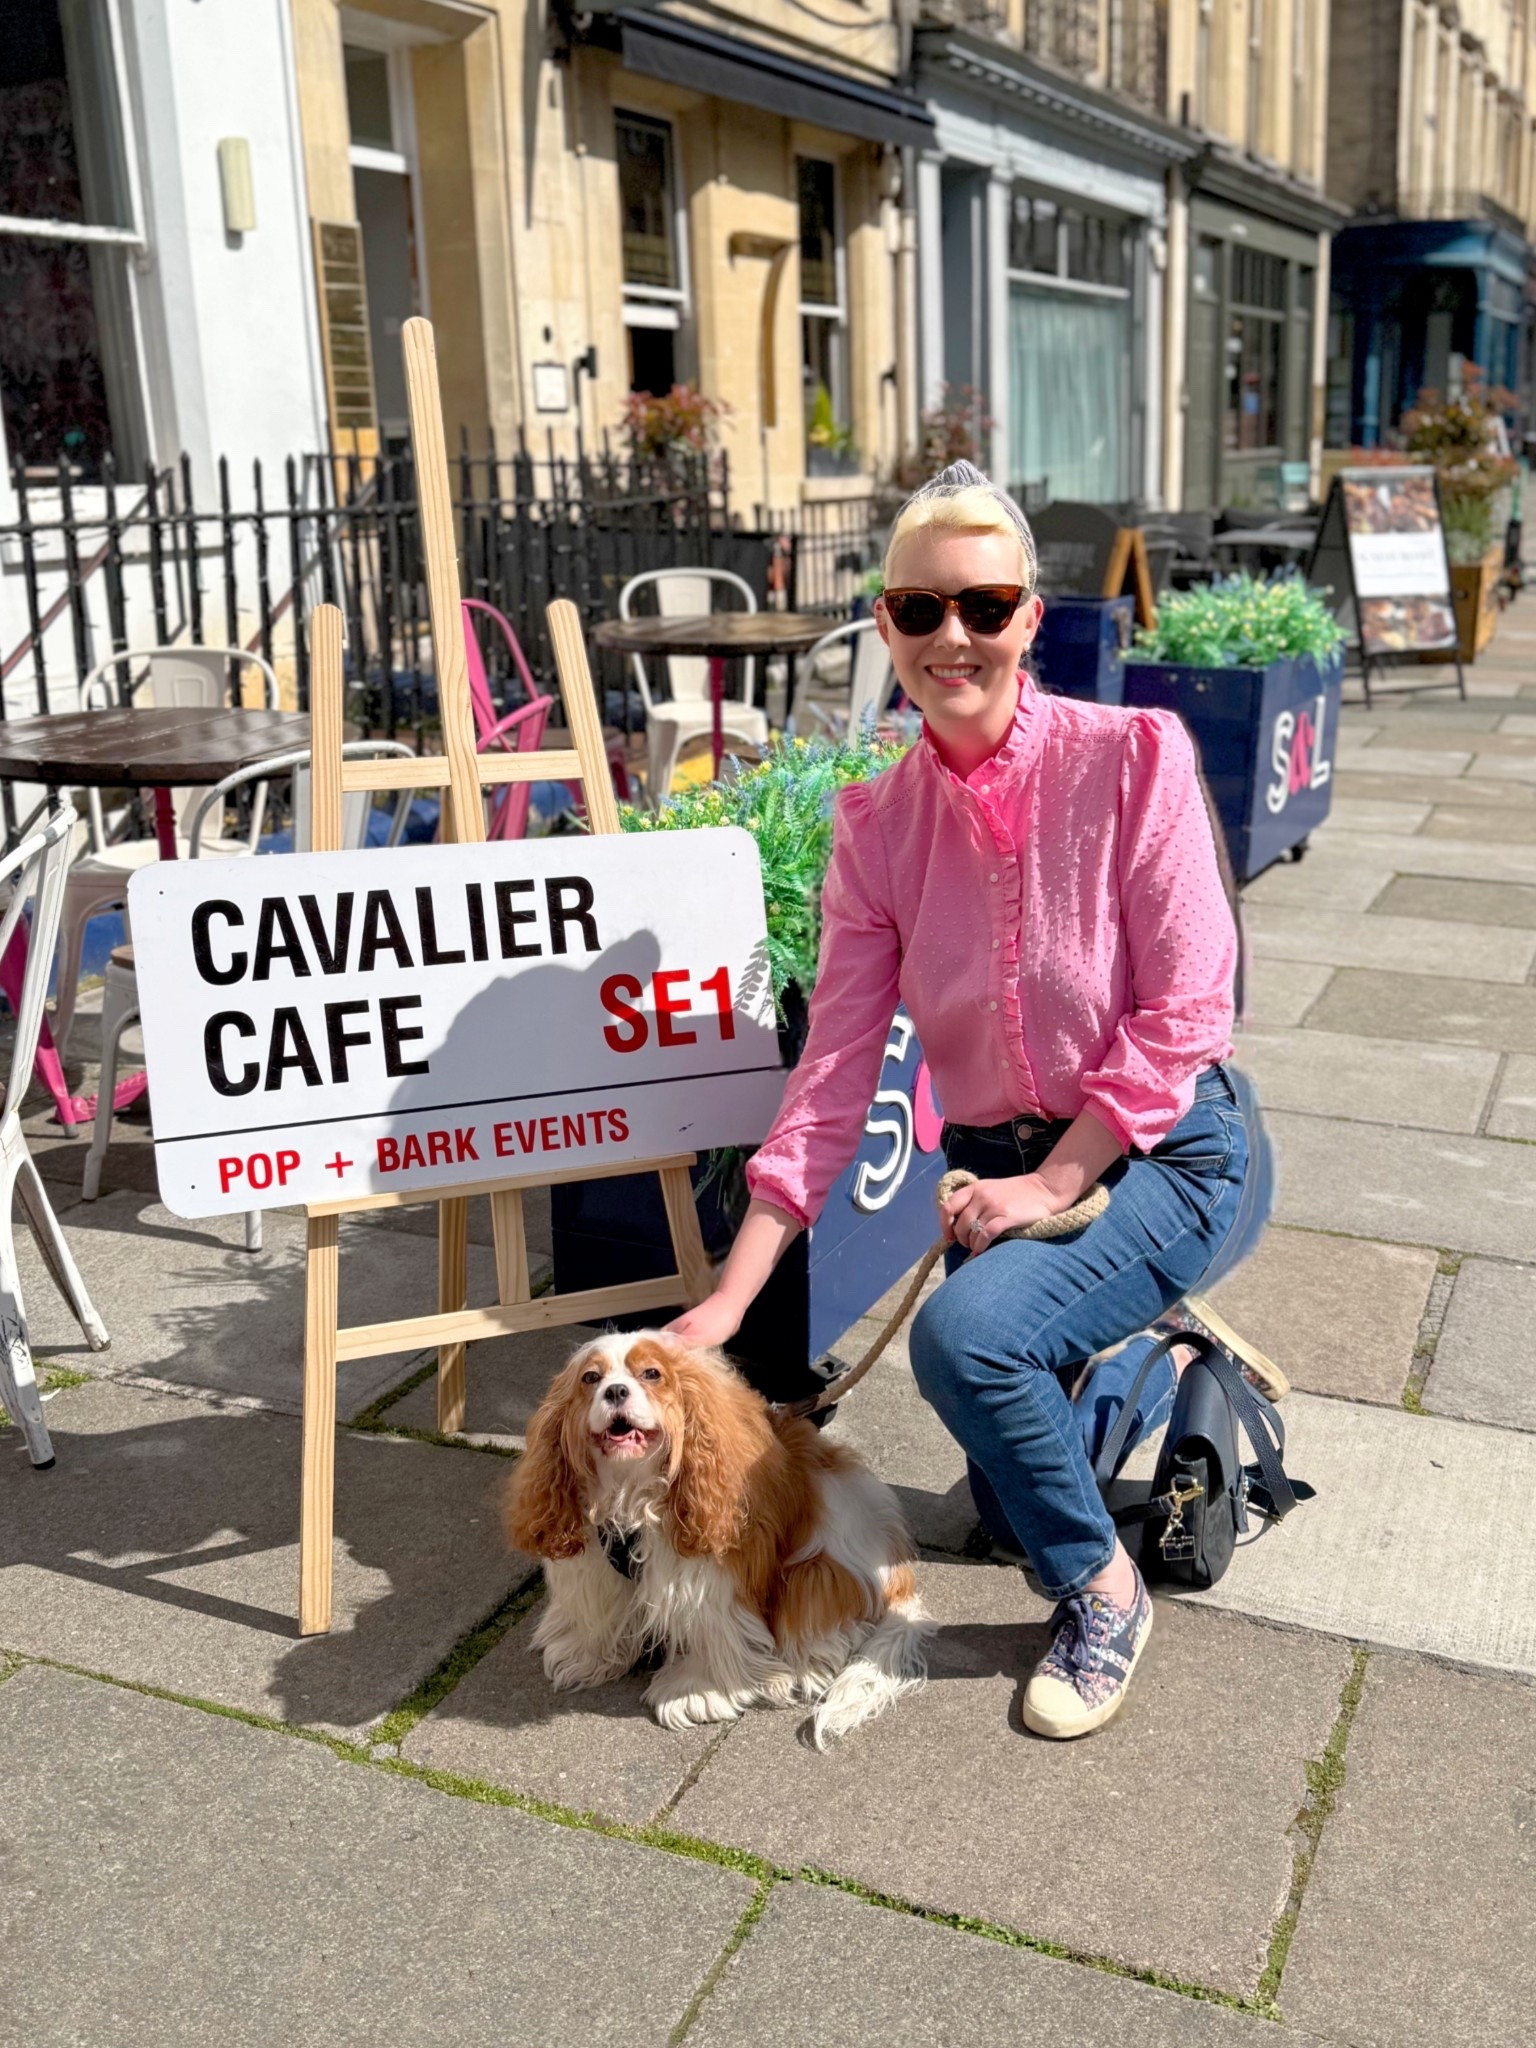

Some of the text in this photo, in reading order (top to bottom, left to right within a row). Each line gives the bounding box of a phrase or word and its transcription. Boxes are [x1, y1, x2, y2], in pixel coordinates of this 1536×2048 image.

[191, 876, 602, 986] CAVALIER
[204, 995, 430, 1097] CAFE
[600, 966, 736, 1053] SE1
[218, 1108, 630, 1193] POP + BARK EVENTS
